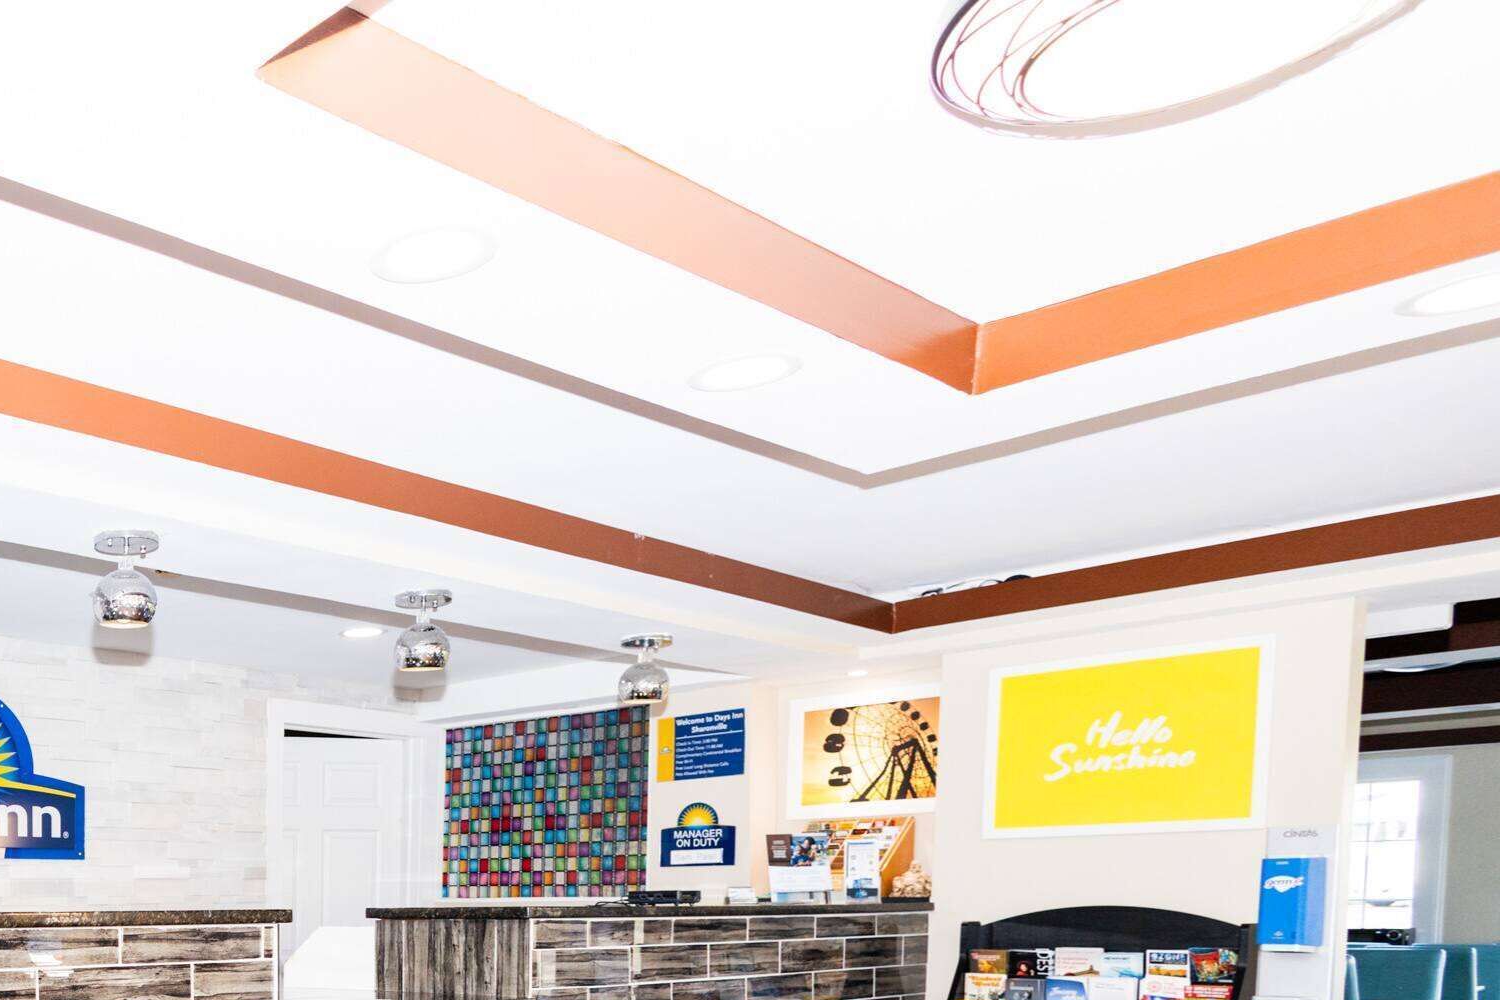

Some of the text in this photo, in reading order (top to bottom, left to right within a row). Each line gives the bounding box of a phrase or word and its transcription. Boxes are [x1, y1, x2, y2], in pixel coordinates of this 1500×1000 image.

[676, 717, 705, 726] Welcome
[714, 714, 731, 722] Days
[732, 712, 744, 720] Inn
[691, 723, 728, 733] Sharonville
[1085, 710, 1173, 749] Hello
[1044, 742, 1196, 782] Sunshine
[673, 829, 723, 839] MANAGER
[676, 838, 720, 848] ON DUTY
